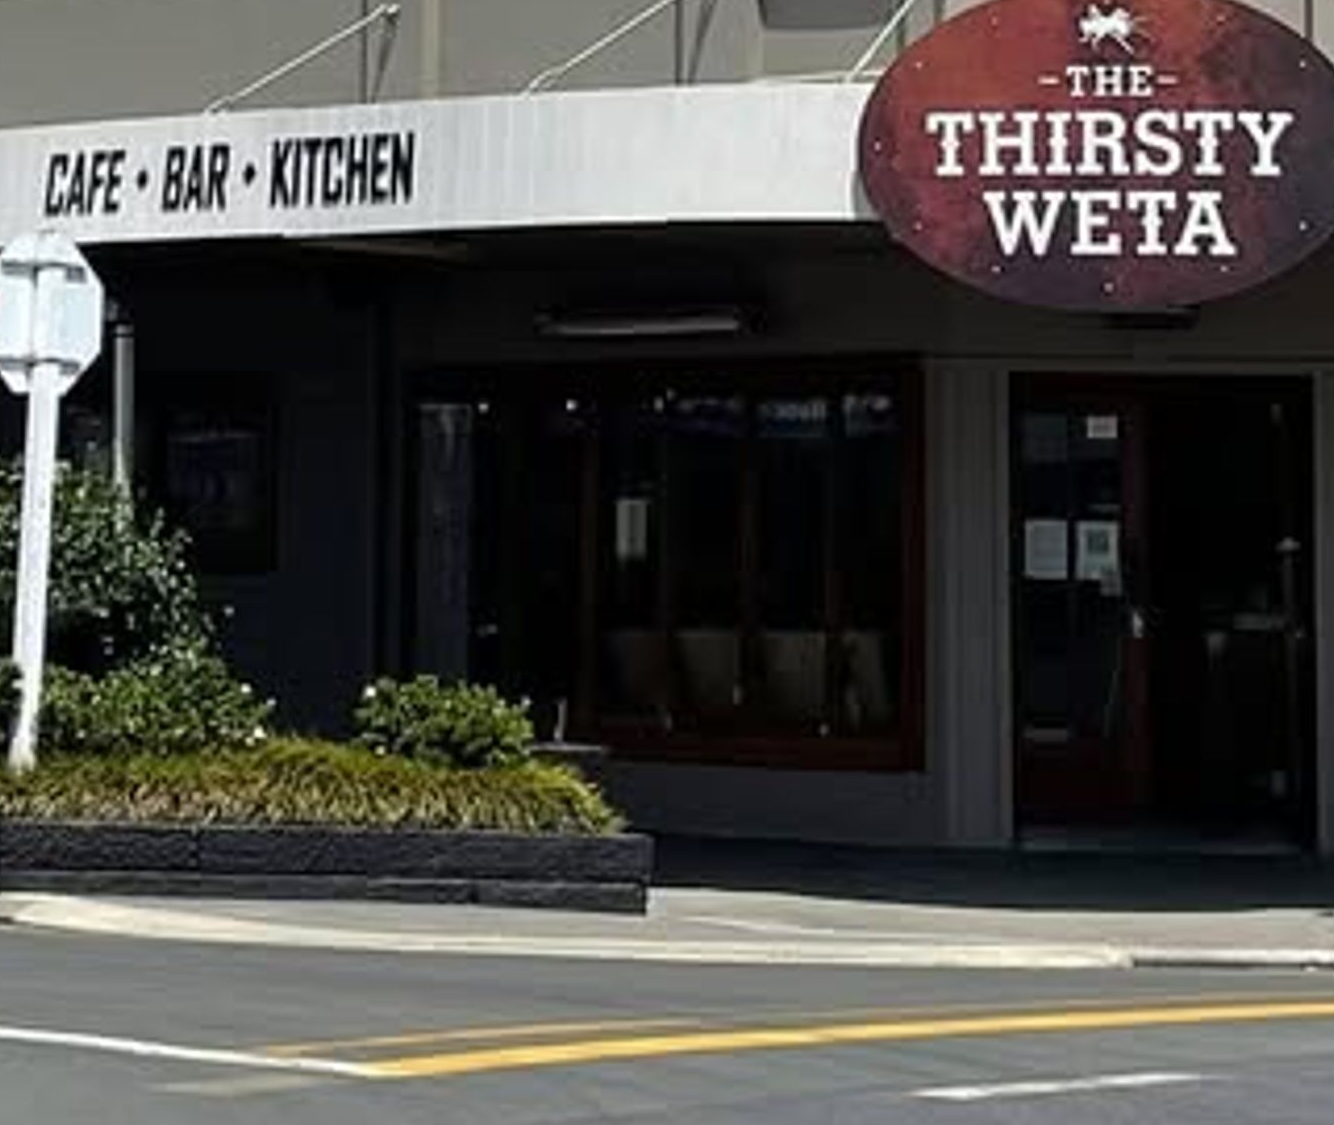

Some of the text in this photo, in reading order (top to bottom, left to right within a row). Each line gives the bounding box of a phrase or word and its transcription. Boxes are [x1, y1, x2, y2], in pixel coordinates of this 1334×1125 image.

[1066, 65, 1153, 97] THE
[45, 131, 414, 217] CAFE BAR KITCHEN
[926, 110, 1293, 176] THIRSTY
[983, 191, 1236, 255] WETA
